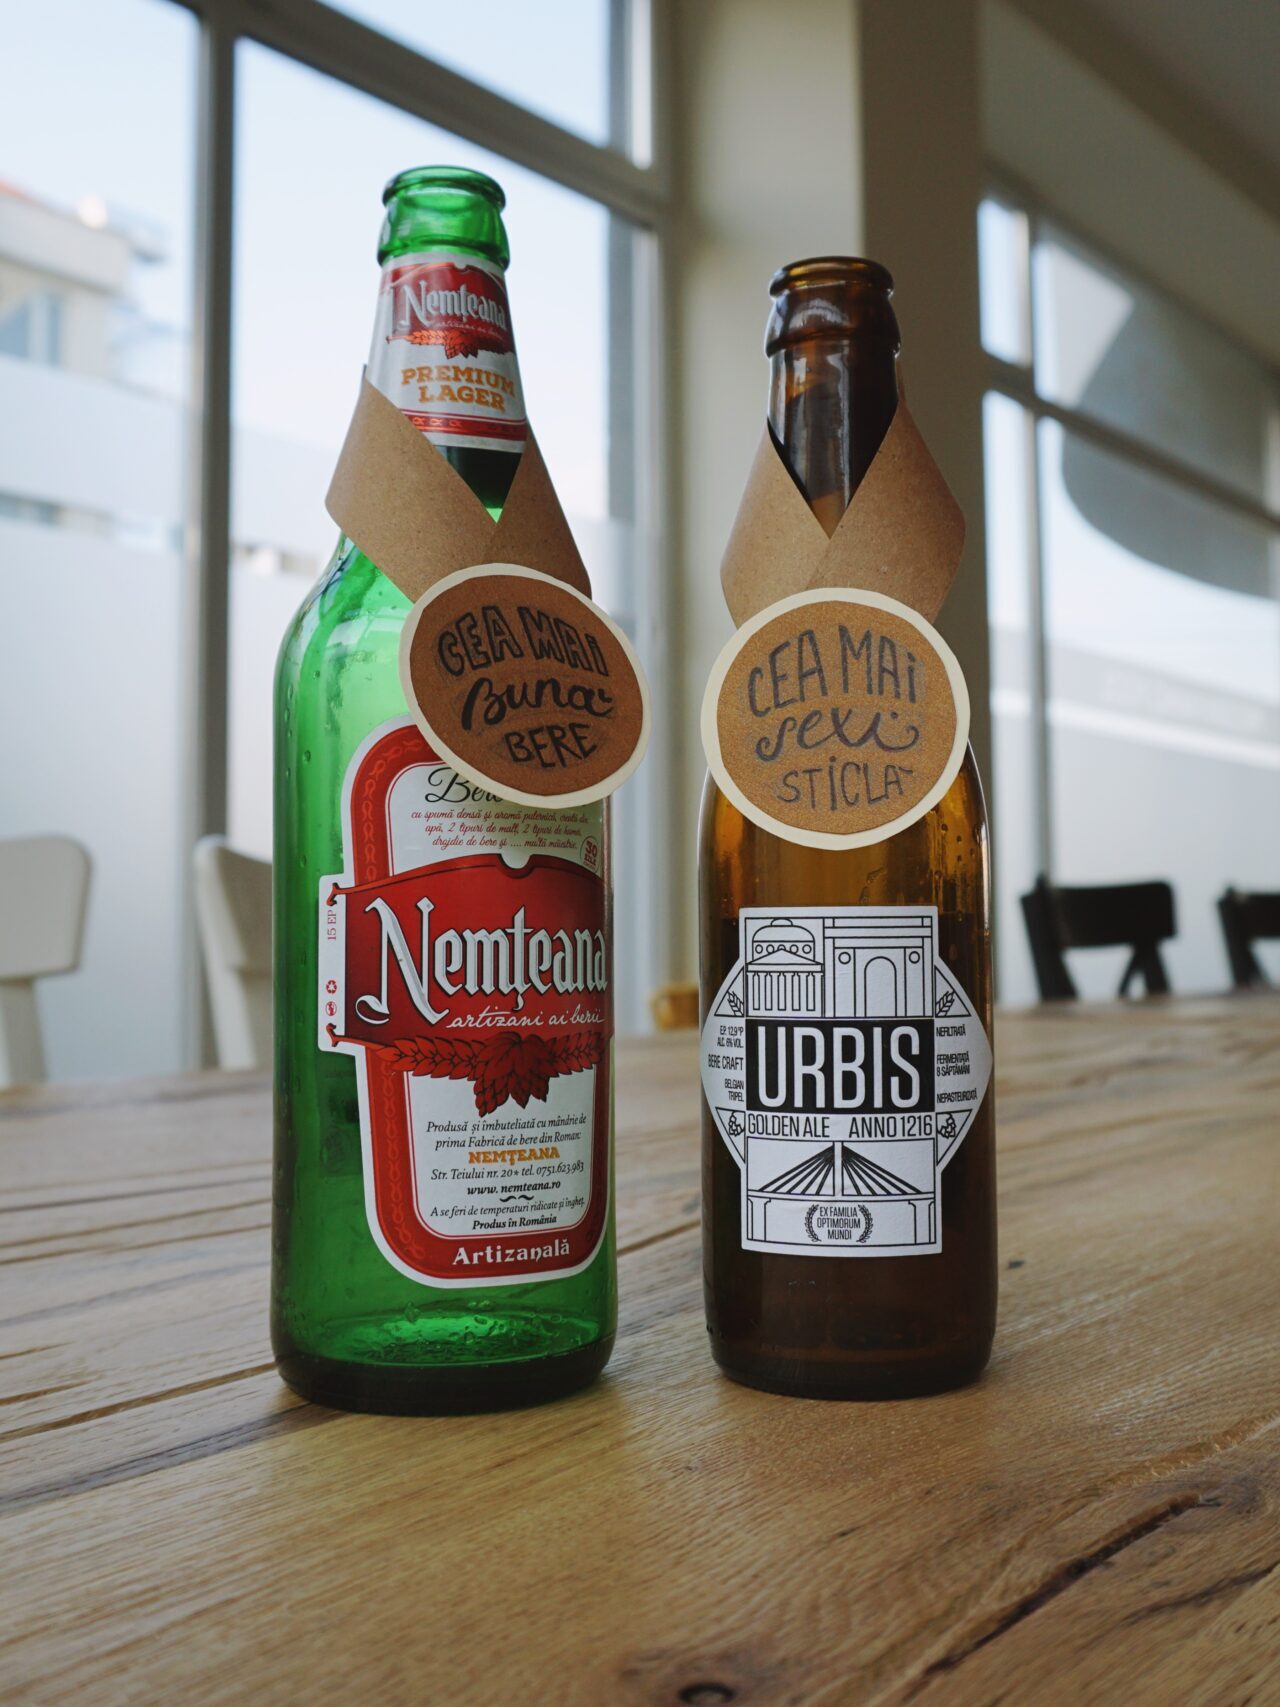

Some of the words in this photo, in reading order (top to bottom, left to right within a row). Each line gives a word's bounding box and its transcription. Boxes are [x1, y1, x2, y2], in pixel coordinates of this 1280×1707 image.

[401, 365, 516, 398] PREMIUM
[418, 384, 506, 413] LAGER
[438, 604, 525, 678] CEA
[516, 606, 609, 677] MAI
[747, 629, 829, 718] CEA
[755, 706, 920, 763] sexi
[504, 722, 598, 769] BERE
[410, 810, 422, 819] cu
[424, 808, 455, 823] spumă
[456, 807, 483, 820] densă
[494, 810, 522, 820] aromă
[447, 821, 456, 833] 2
[458, 821, 484, 836] tipuri
[485, 821, 497, 833] de
[522, 823, 530, 834] 2
[432, 835, 464, 851] drojdie
[465, 835, 477, 847] de
[479, 834, 498, 847] bere
[327, 909, 337, 924] EP
[446, 1005, 544, 1029] artizani
[548, 1009, 569, 1026] ai
[936, 1023, 967, 1037] NEFILTRATĂ
[707, 1053, 721, 1069] BERE
[721, 1056, 744, 1071] CRAFT
[936, 1050, 970, 1065] FERMENTATĂ
[756, 1025, 921, 1110] URBIS
[936, 1066, 941, 1077] 8
[724, 1078, 744, 1091] BELGIAN
[728, 1090, 745, 1103] TRIPEL
[426, 1120, 469, 1133] Produsă
[471, 1119, 481, 1135] și
[481, 1118, 536, 1131] îmbuteliată
[536, 1120, 547, 1129] cu
[548, 1113, 578, 1128] mândrie
[578, 1112, 587, 1125] de
[747, 1113, 801, 1137] GOLDEN
[802, 1115, 831, 1138] ALE
[848, 1115, 898, 1139] ANNO
[900, 1114, 933, 1137] 1216
[434, 1136, 466, 1152] prima
[468, 1134, 505, 1148] Fabrică
[506, 1134, 518, 1147] de
[519, 1133, 538, 1146] bere
[539, 1131, 553, 1144] din
[430, 1168, 448, 1181] Str.
[450, 1167, 485, 1180] Teiului
[486, 1169, 499, 1179] nr.
[430, 1205, 439, 1217] A
[440, 1208, 450, 1217] se
[448, 1205, 467, 1220] feri
[467, 1205, 479, 1216] de
[480, 1201, 529, 1217] temperaturi
[530, 1199, 558, 1213] ridicate
[819, 1206, 830, 1218] EX
[830, 1206, 858, 1219] FAMILIA
[472, 1218, 507, 1231] Produs
[507, 1217, 518, 1229] în
[518, 1213, 557, 1227] România
[816, 1217, 861, 1230] OPTIMORUM
[827, 1229, 852, 1241] MUNDI
